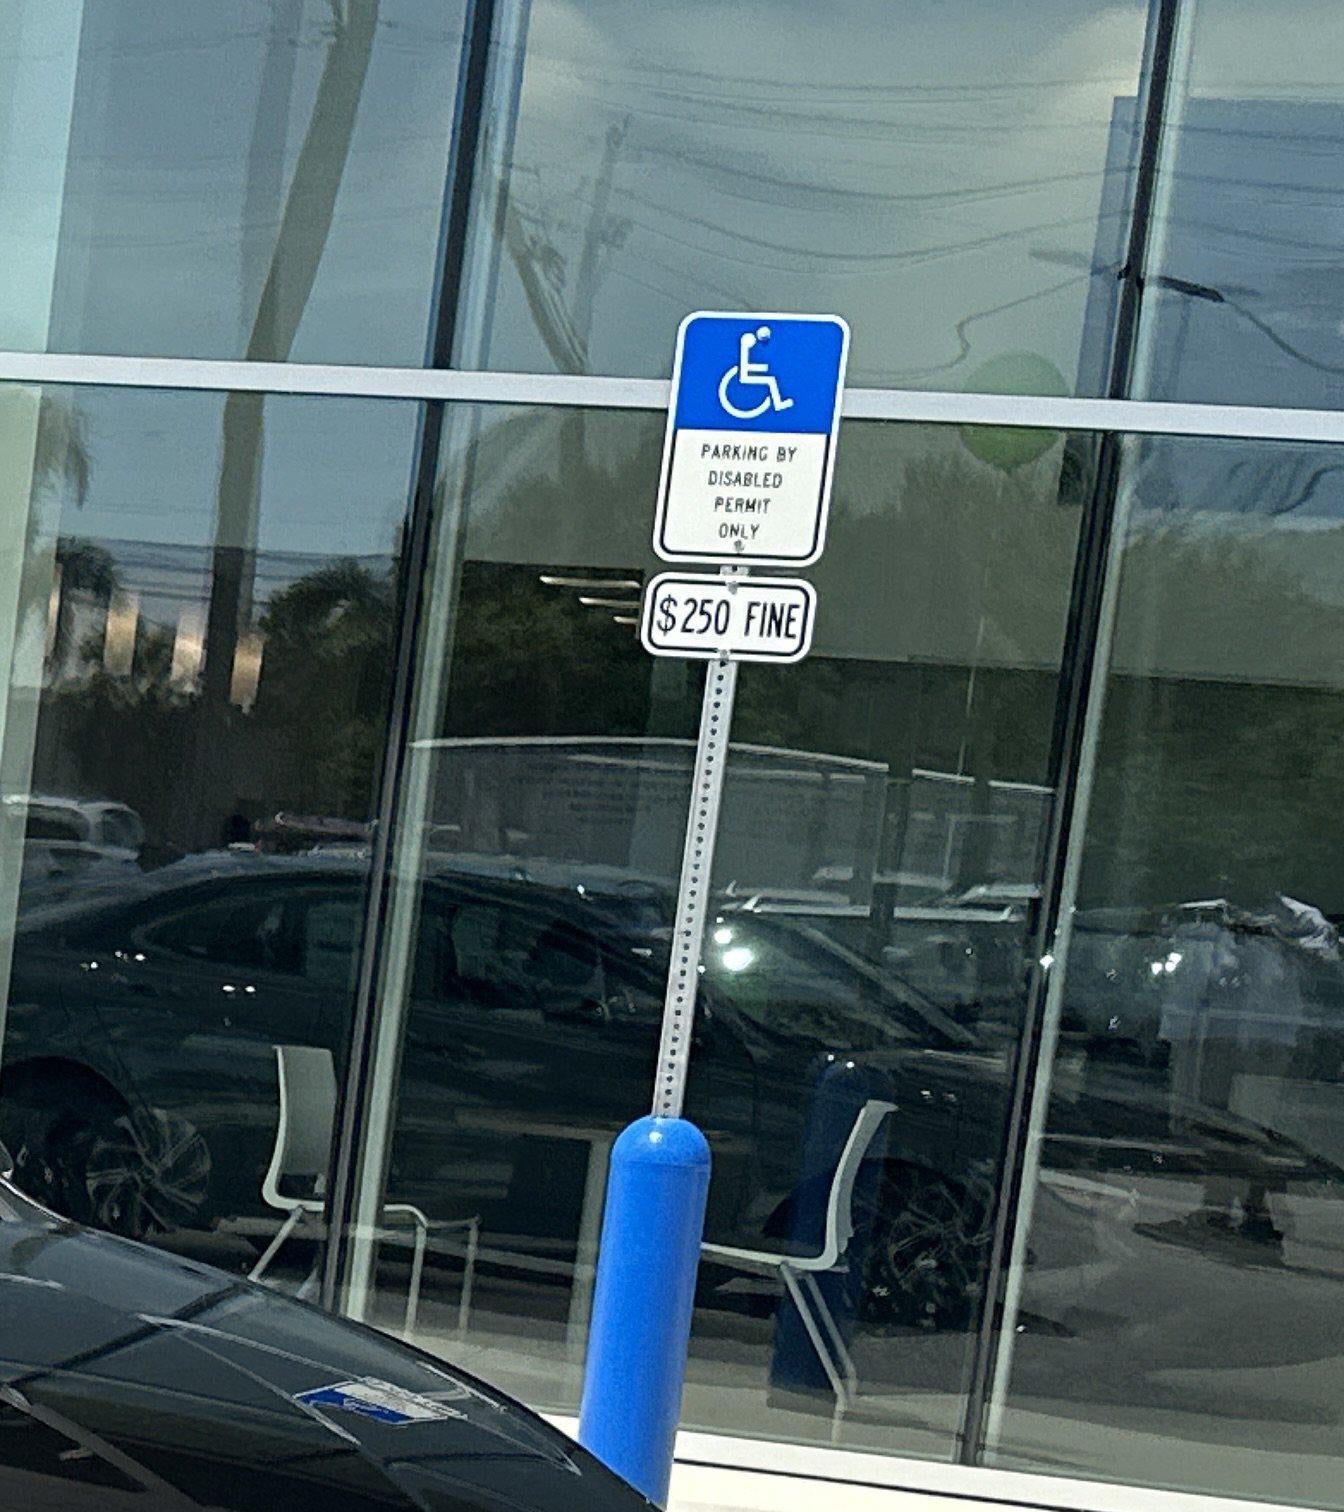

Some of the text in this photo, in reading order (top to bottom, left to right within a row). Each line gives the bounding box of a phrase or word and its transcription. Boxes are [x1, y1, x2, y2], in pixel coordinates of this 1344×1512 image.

[701, 443, 798, 463] PARKING BY
[708, 469, 783, 489] DISABLED
[714, 495, 771, 514] PERMIT
[718, 521, 760, 540] ONLY
[657, 594, 801, 639] $250 FINE
